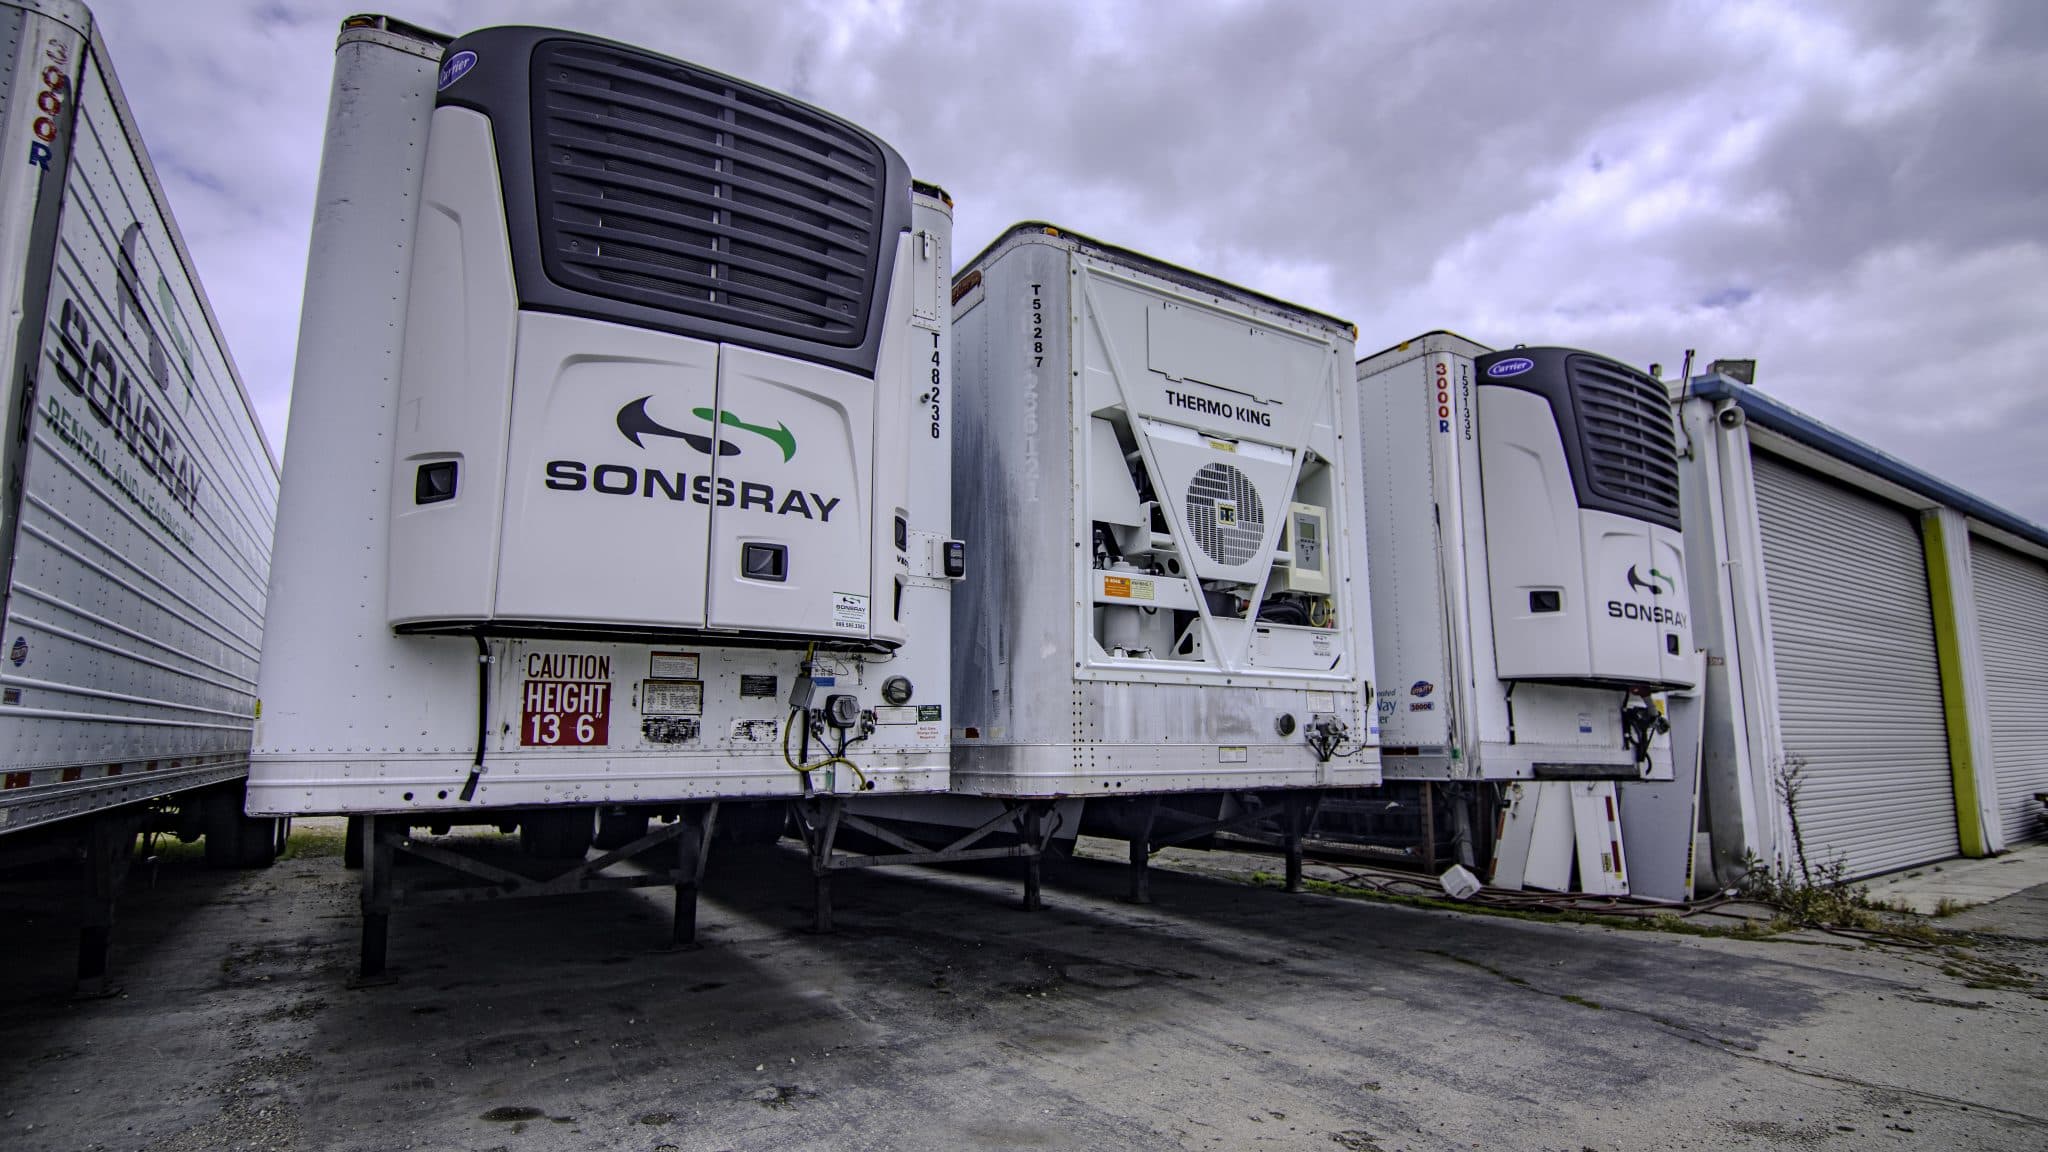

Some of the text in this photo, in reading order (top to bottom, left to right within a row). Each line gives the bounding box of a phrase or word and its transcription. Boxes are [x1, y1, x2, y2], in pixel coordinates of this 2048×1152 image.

[1031, 284, 1044, 368] T53287
[930, 332, 941, 440] T48236
[1435, 362, 1449, 433] 3000R
[1492, 361, 1528, 375] Carrier
[55, 298, 202, 519] SONSRAY
[1165, 390, 1272, 428] THERMO KING
[1460, 363, 1472, 441] T531335
[545, 460, 841, 523] SONSRAY
[1607, 600, 1687, 629] SONSRAY
[527, 652, 611, 680] CAUTION
[526, 682, 607, 714] HEIGHT
